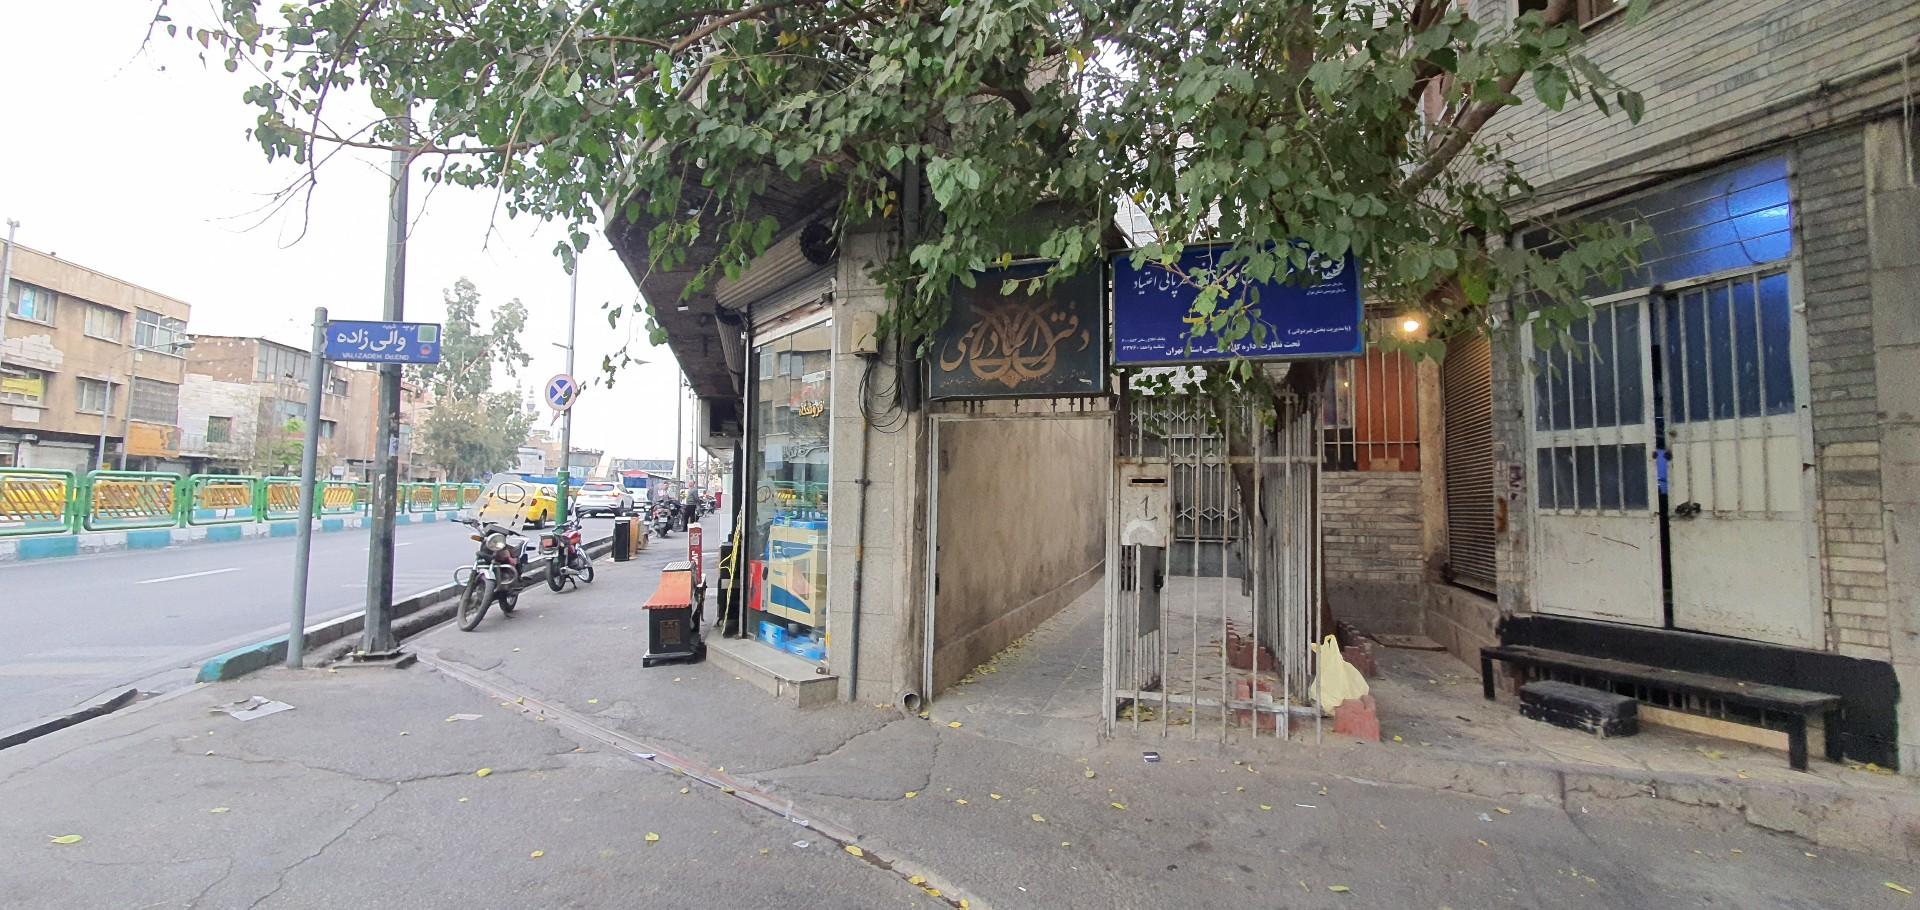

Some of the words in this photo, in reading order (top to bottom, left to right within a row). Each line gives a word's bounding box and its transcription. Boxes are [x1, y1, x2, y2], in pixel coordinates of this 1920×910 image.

[1134, 271, 1158, 295] اعتیاد
[336, 327, 369, 351] زاده
[1031, 301, 1090, 367] دفتر
[369, 328, 407, 352] والی
[1284, 339, 1301, 348] تحت
[1187, 345, 1202, 353] استا
[1241, 342, 1257, 352] داره
[1260, 340, 1283, 351] نظارت
[341, 351, 382, 360] VALIZADEH
[1165, 346, 1184, 356] تهران
